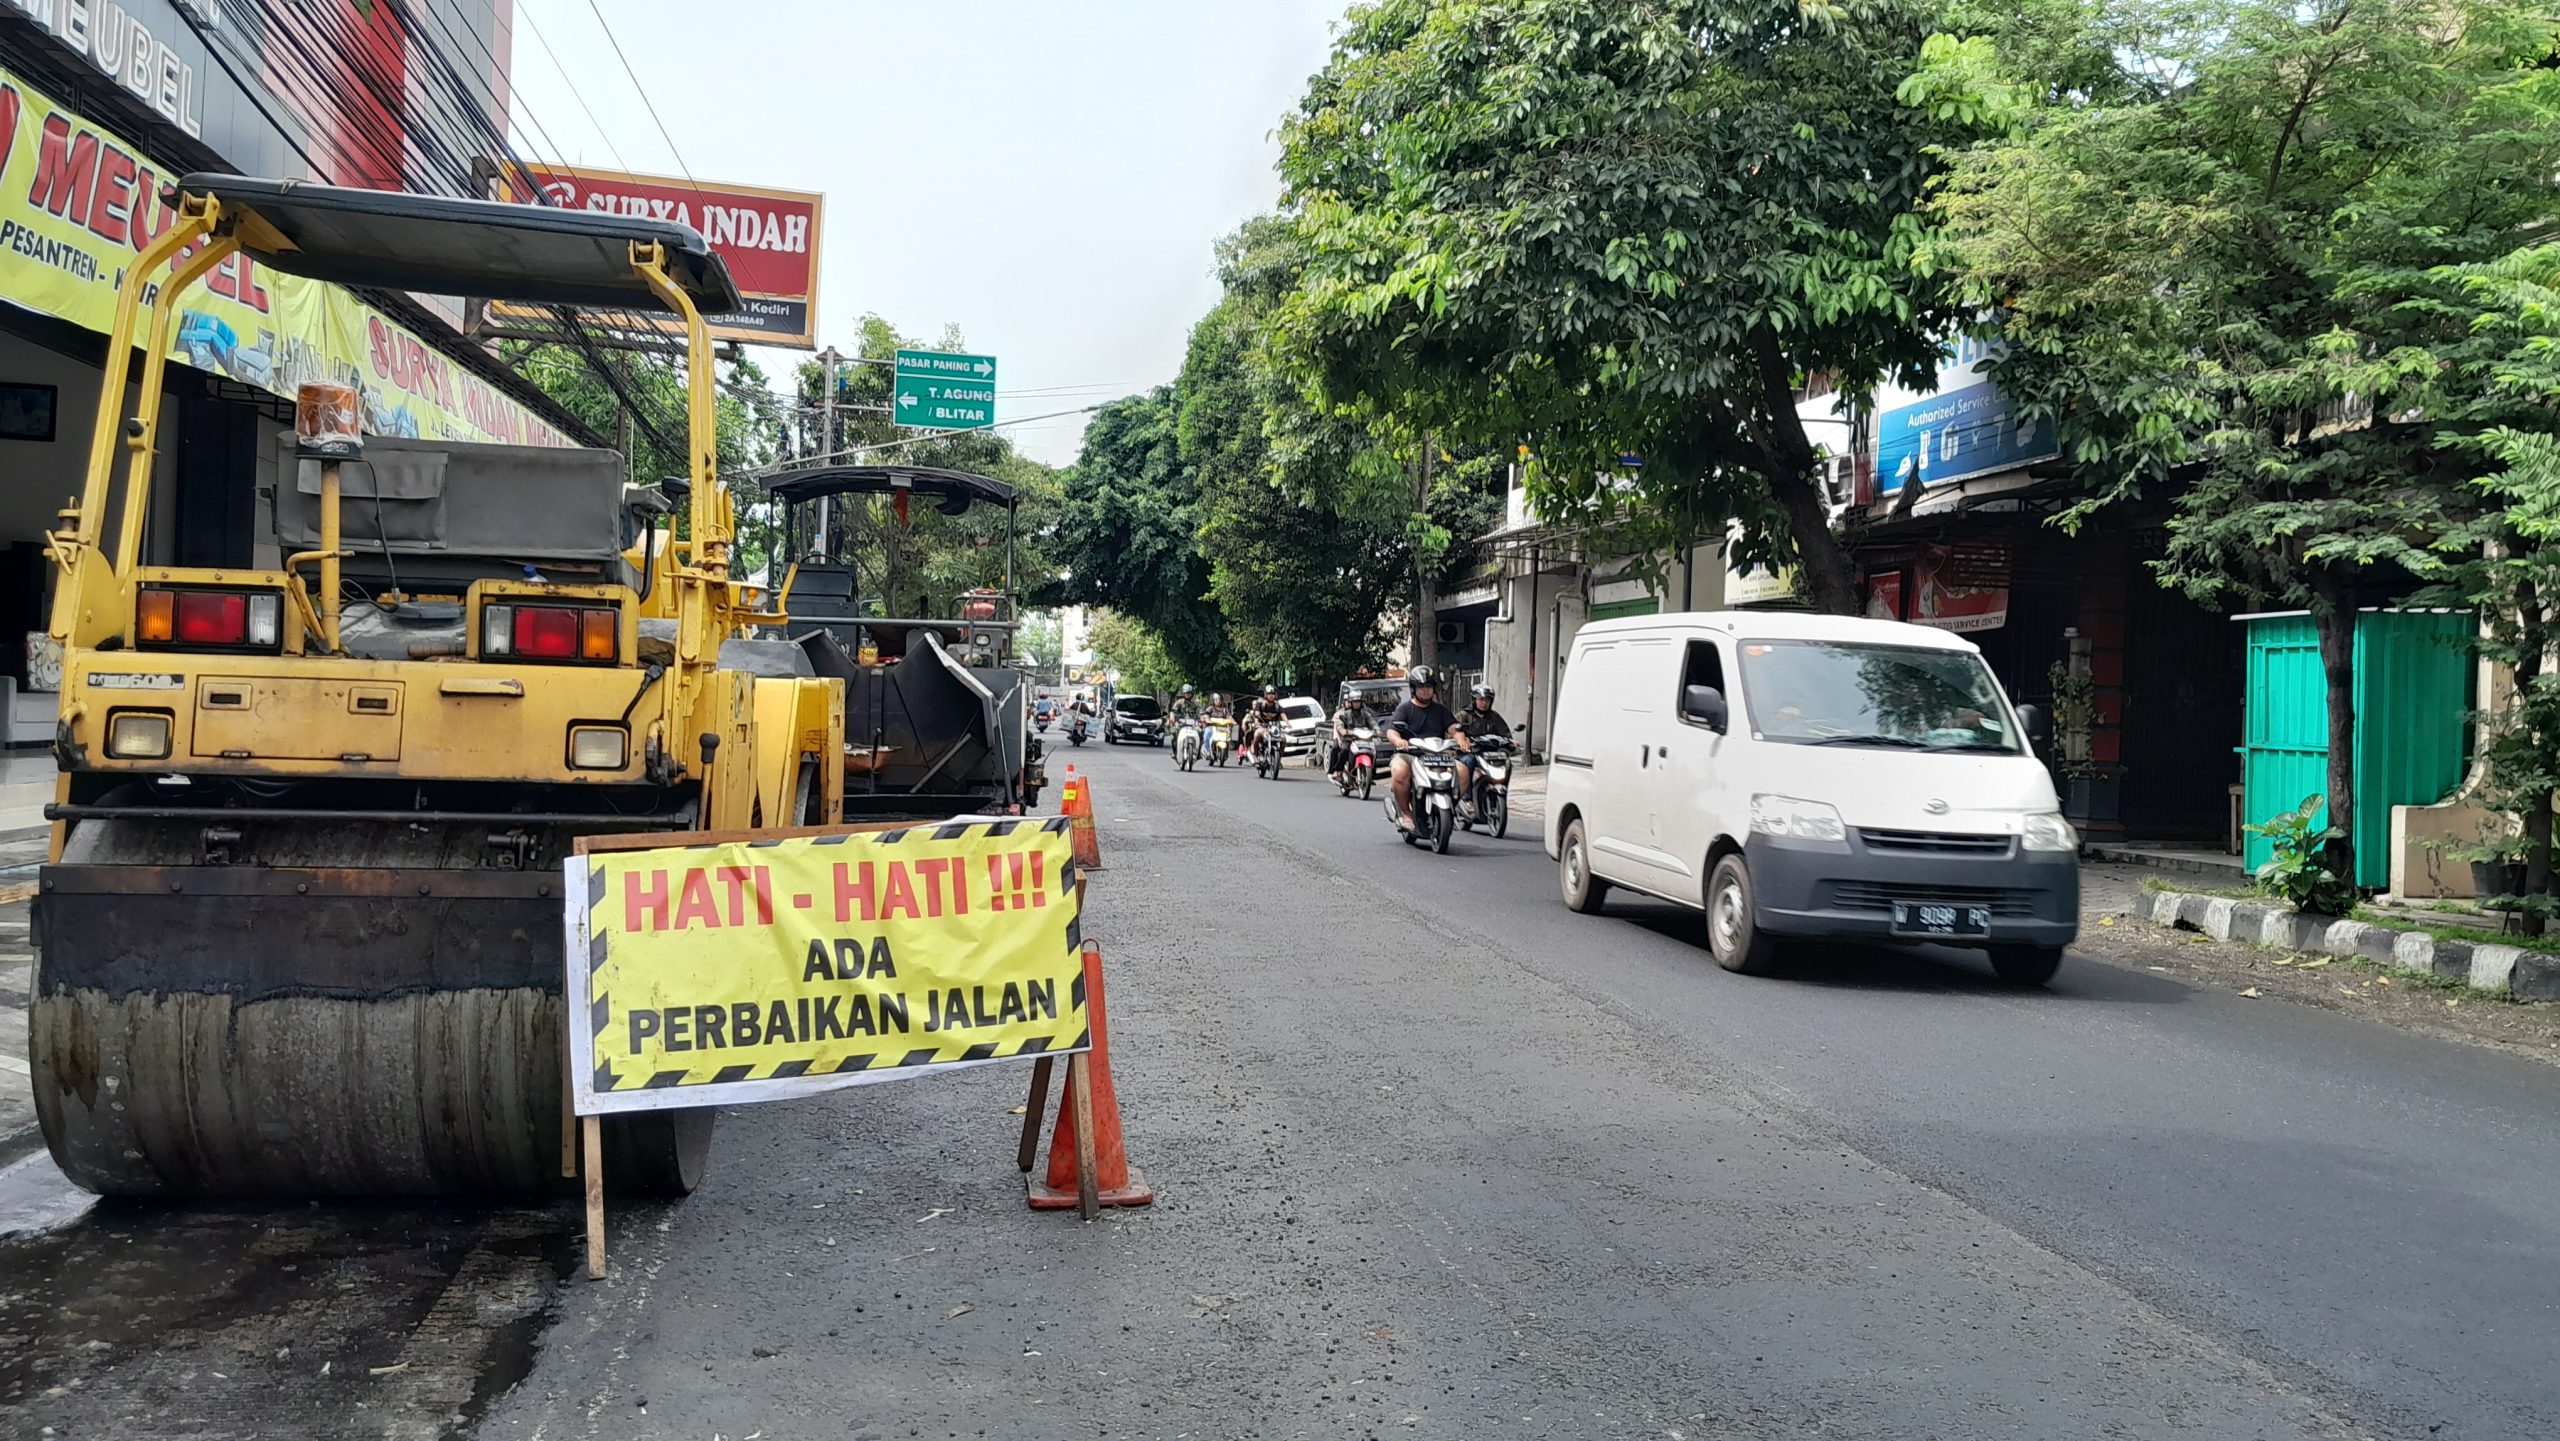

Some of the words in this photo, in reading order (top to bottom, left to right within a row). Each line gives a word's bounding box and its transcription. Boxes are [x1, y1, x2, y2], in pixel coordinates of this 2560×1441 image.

[702, 204, 808, 253] INDAH
[1, 220, 97, 282] PESANTREN
[751, 302, 790, 316] Kediri
[368, 315, 459, 418] SURYA
[898, 357, 931, 369] PASAR
[933, 359, 970, 372] PAHING
[928, 387, 941, 399] T.
[944, 388, 993, 402] AGUNG
[936, 407, 985, 421] BLITAR
[1907, 401, 1955, 428] Authorized
[1957, 395, 1991, 415] Service
[1954, 618, 1979, 630] SERVICE
[624, 864, 774, 932] HATI
[833, 857, 969, 922] HATI
[803, 936, 897, 983] ADA
[628, 992, 910, 1055] PERBAIKAN
[924, 977, 1057, 1032] JALAN
